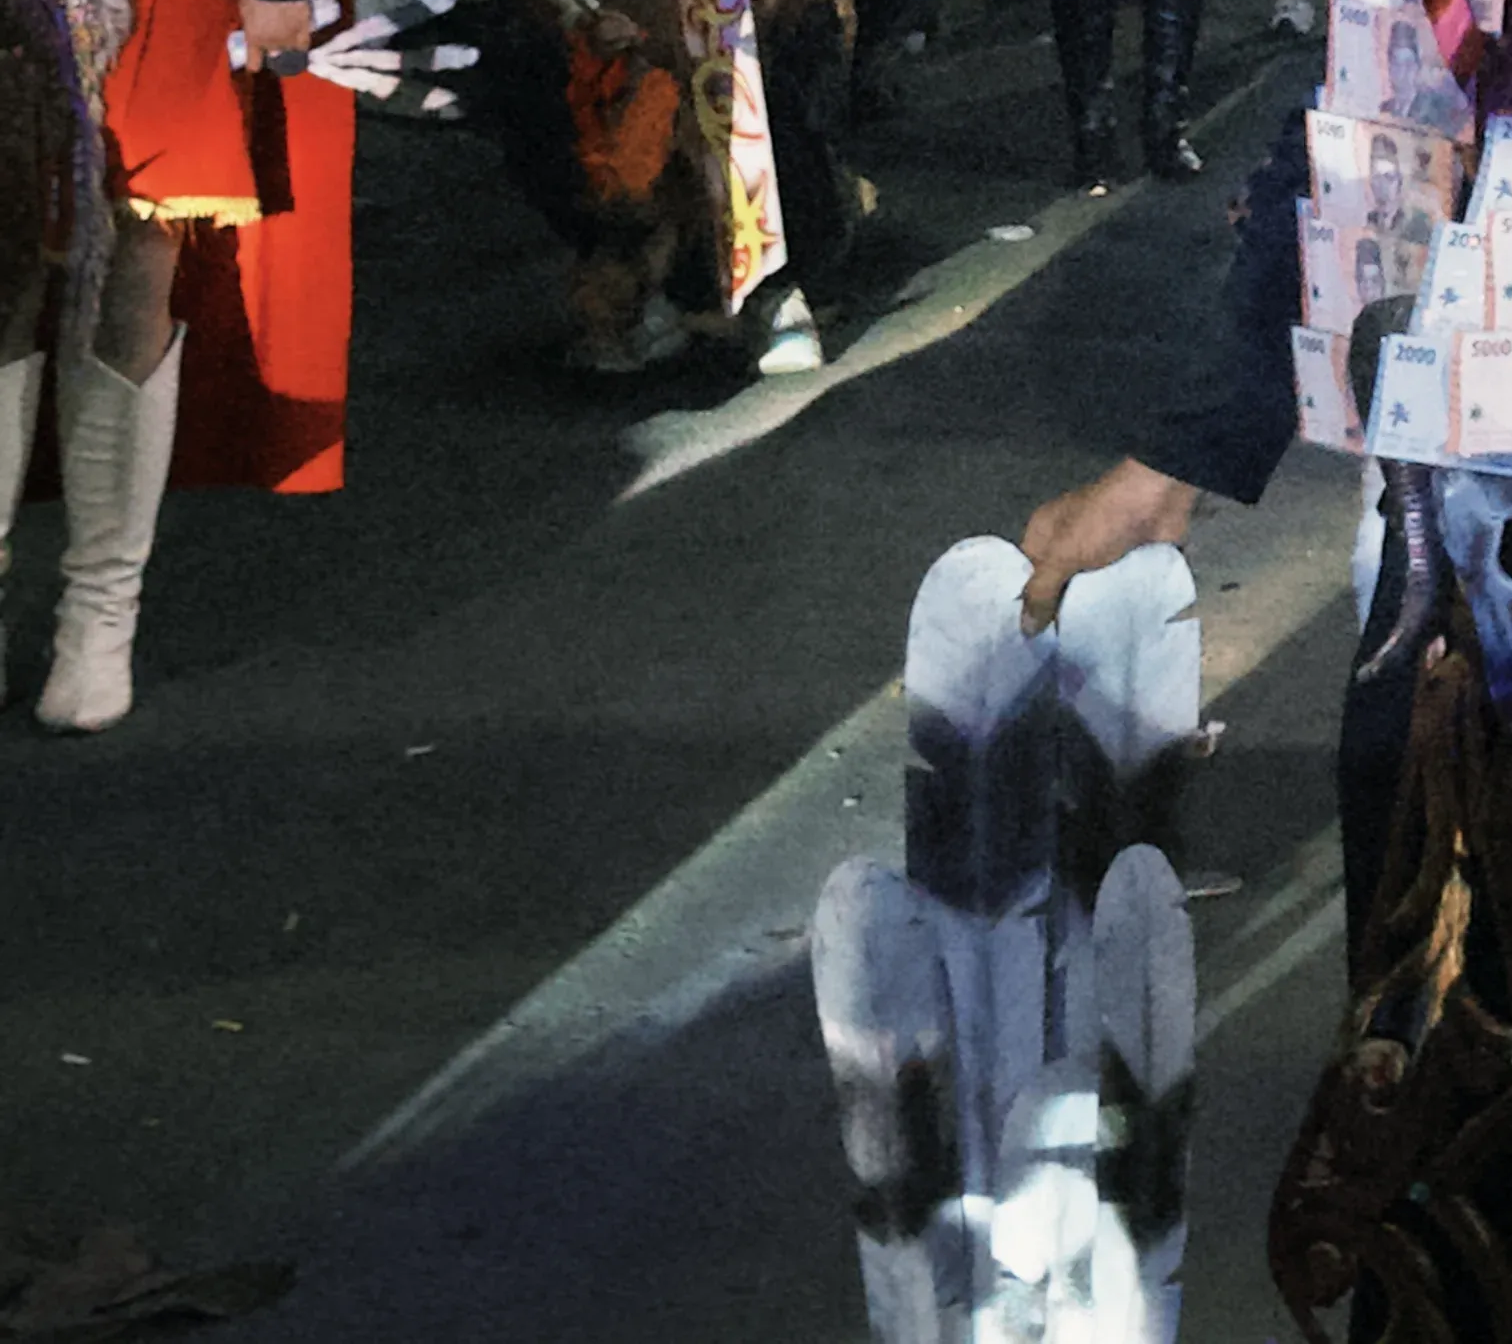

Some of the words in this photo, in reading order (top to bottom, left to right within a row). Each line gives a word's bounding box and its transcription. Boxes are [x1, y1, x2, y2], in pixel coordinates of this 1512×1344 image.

[1448, 230, 1482, 251] 200
[1395, 342, 1437, 366] 2000
[1471, 338, 1512, 358] 5000
